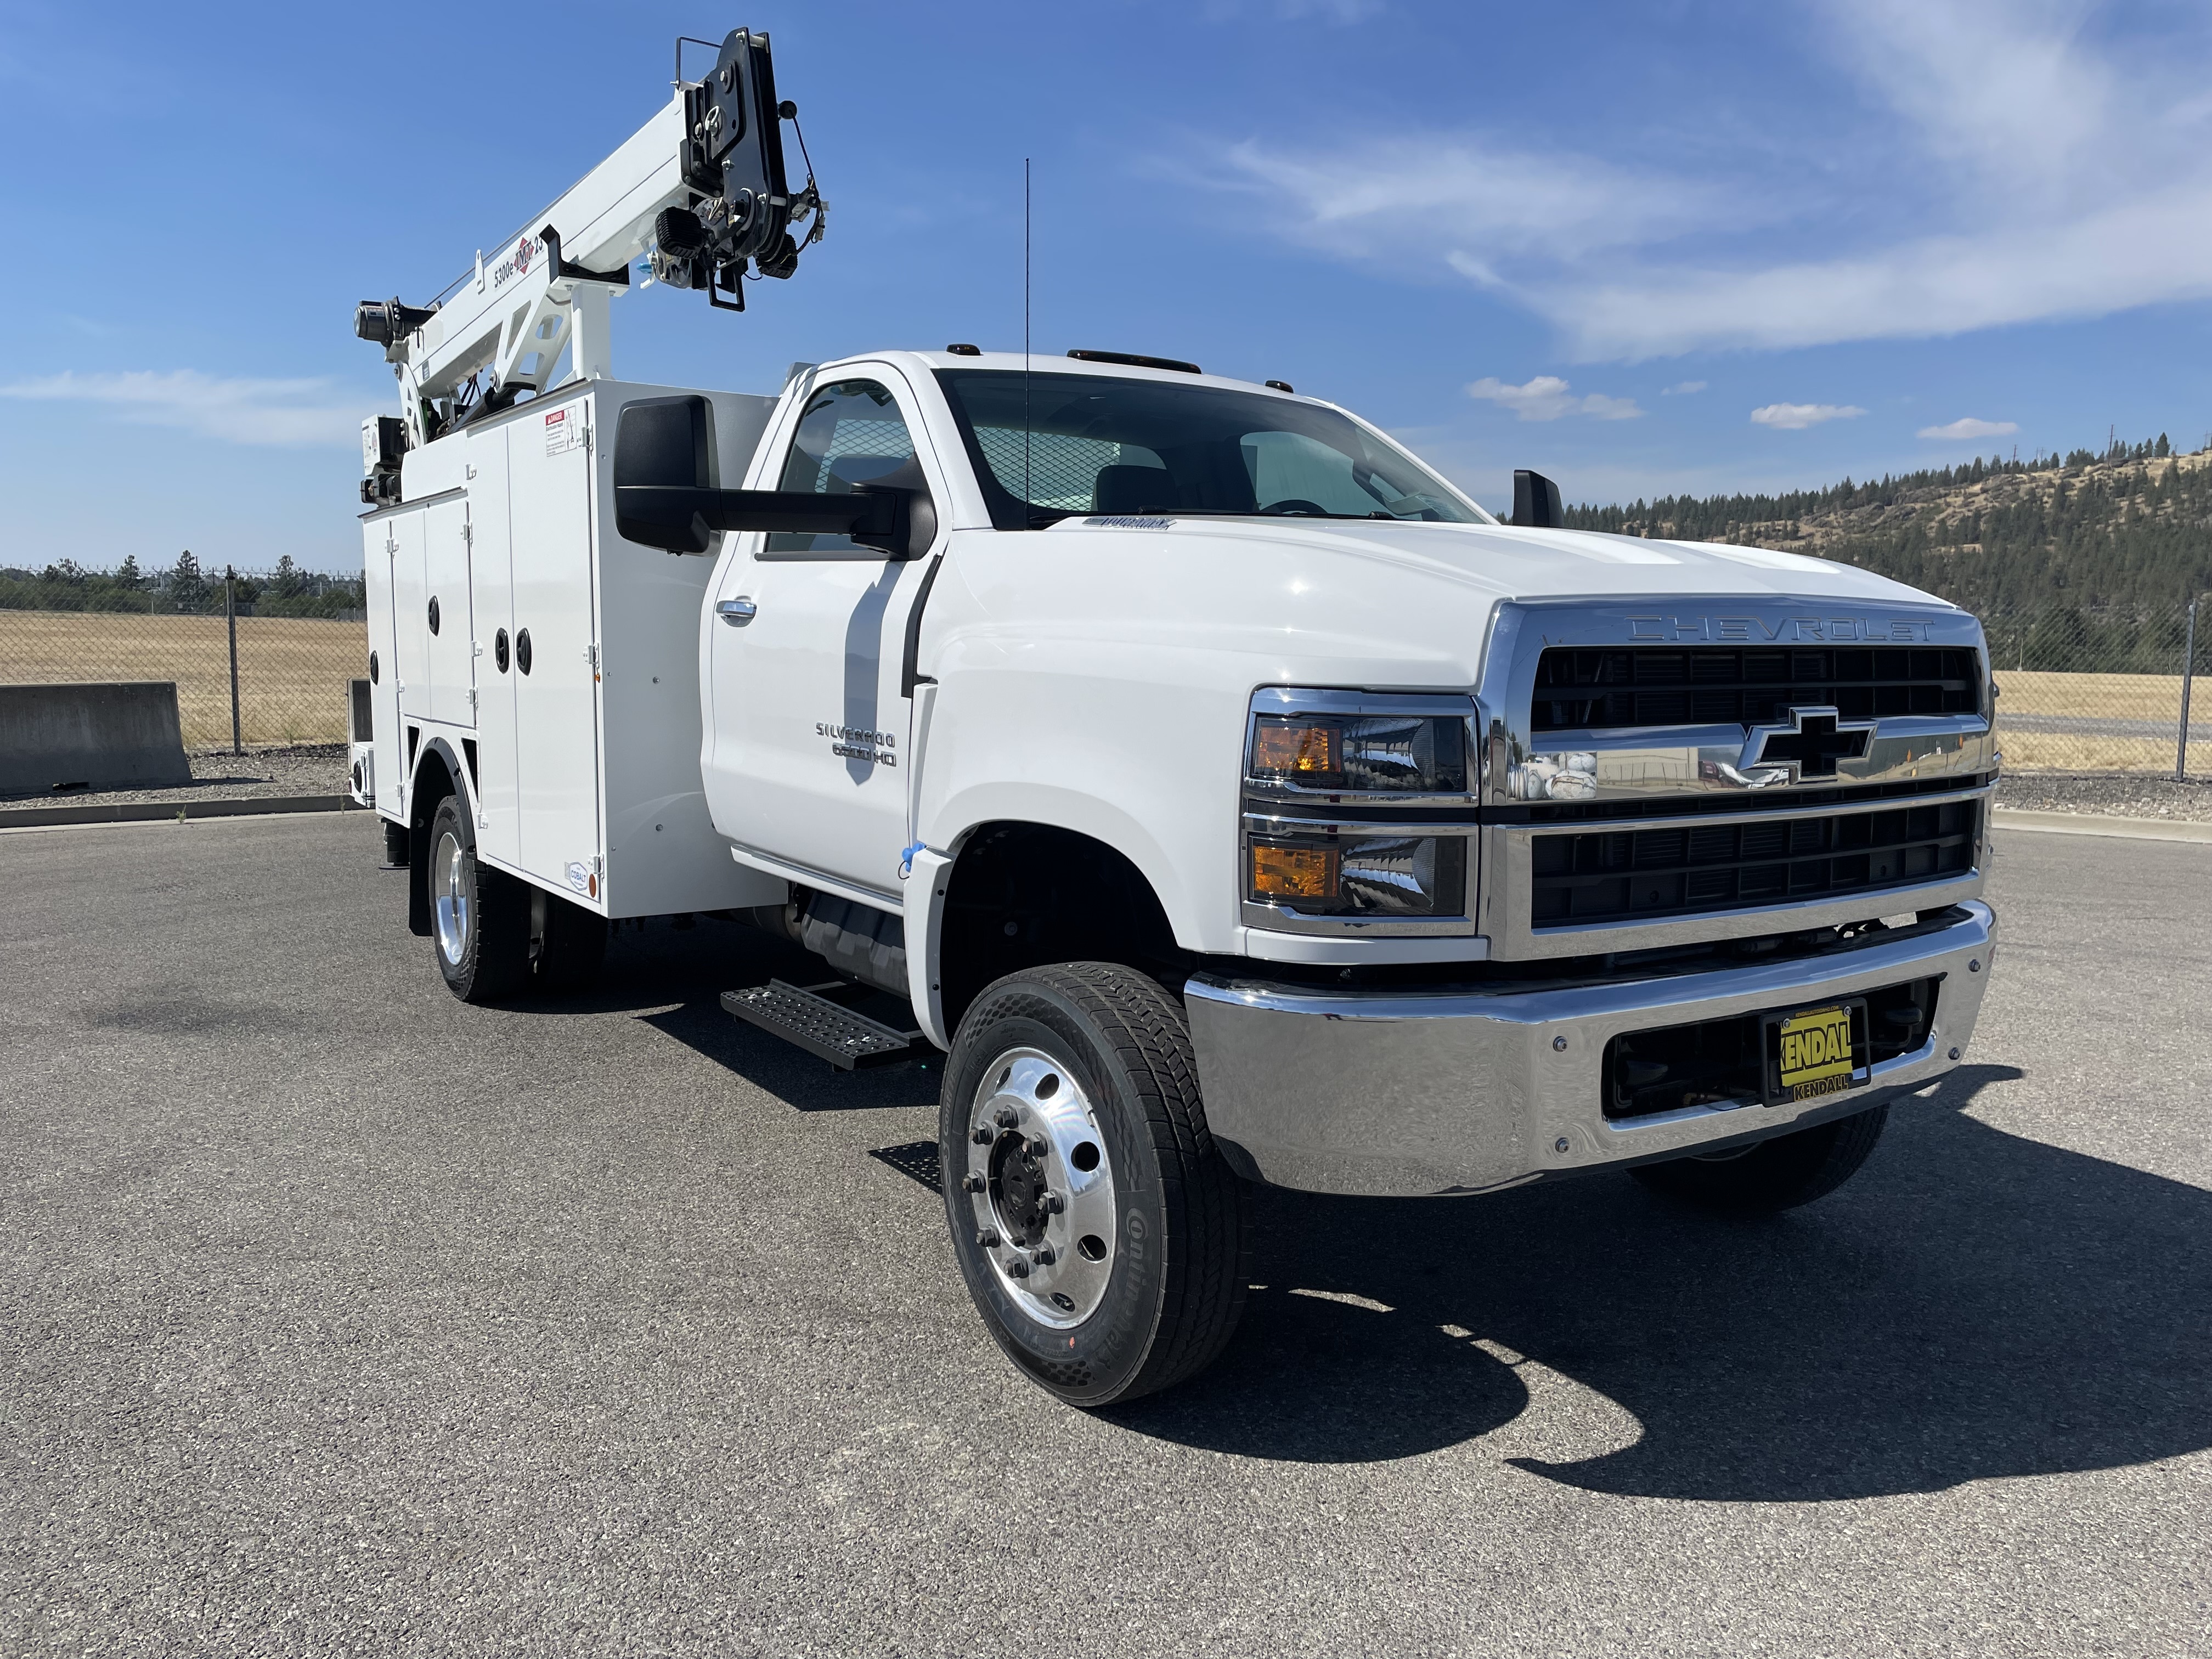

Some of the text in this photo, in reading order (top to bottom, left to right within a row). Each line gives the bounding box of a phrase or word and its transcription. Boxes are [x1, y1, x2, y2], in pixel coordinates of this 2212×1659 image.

[494, 261, 514, 288] 5300e
[516, 241, 533, 270] IMT
[1624, 615, 1936, 641] CHEVROLET
[816, 722, 895, 748] SILVERADO
[571, 870, 586, 883] COBALT
[1793, 1074, 1849, 1102] KENDALL
